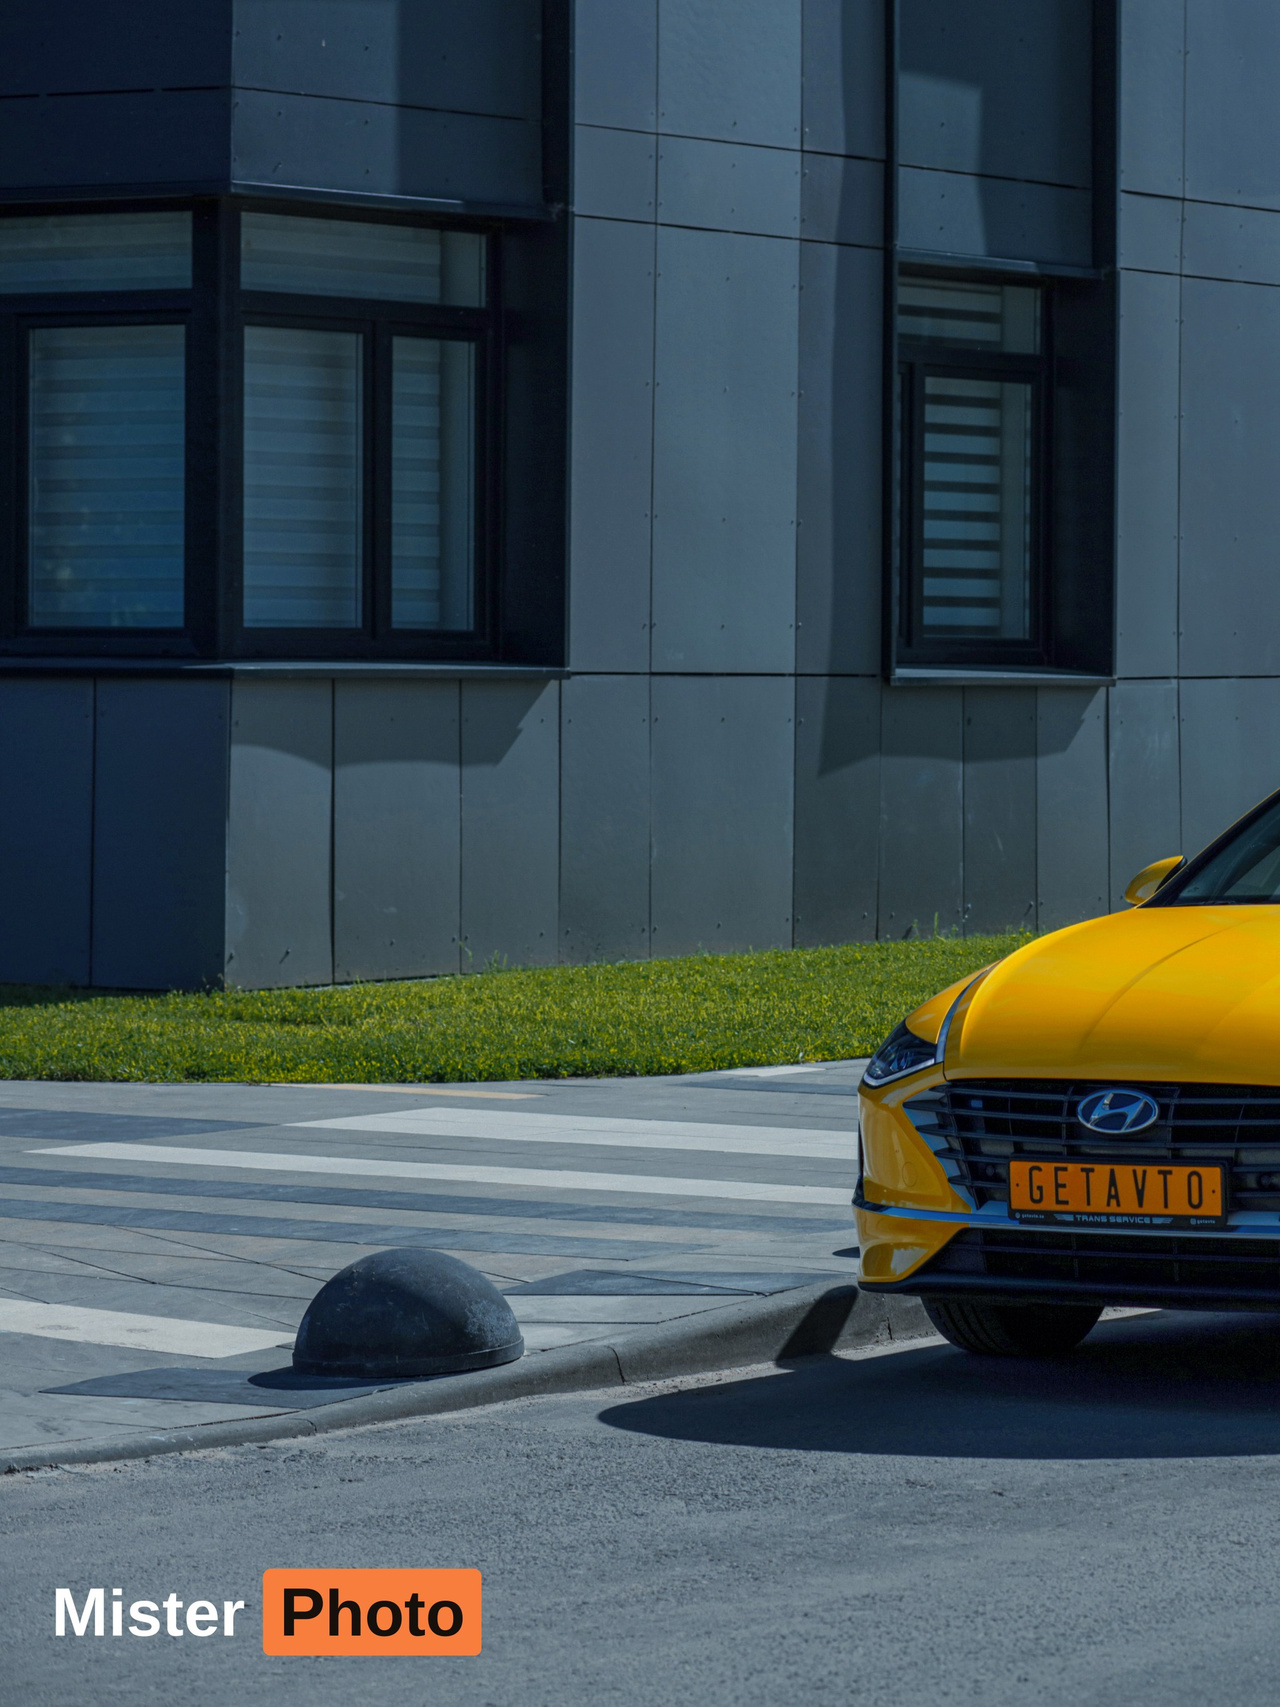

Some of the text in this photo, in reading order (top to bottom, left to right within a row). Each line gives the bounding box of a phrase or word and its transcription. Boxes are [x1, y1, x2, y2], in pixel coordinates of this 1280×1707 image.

[1028, 1165, 1203, 1210] GETAVTO
[1075, 1215, 1151, 1224] TRANS SERVICE
